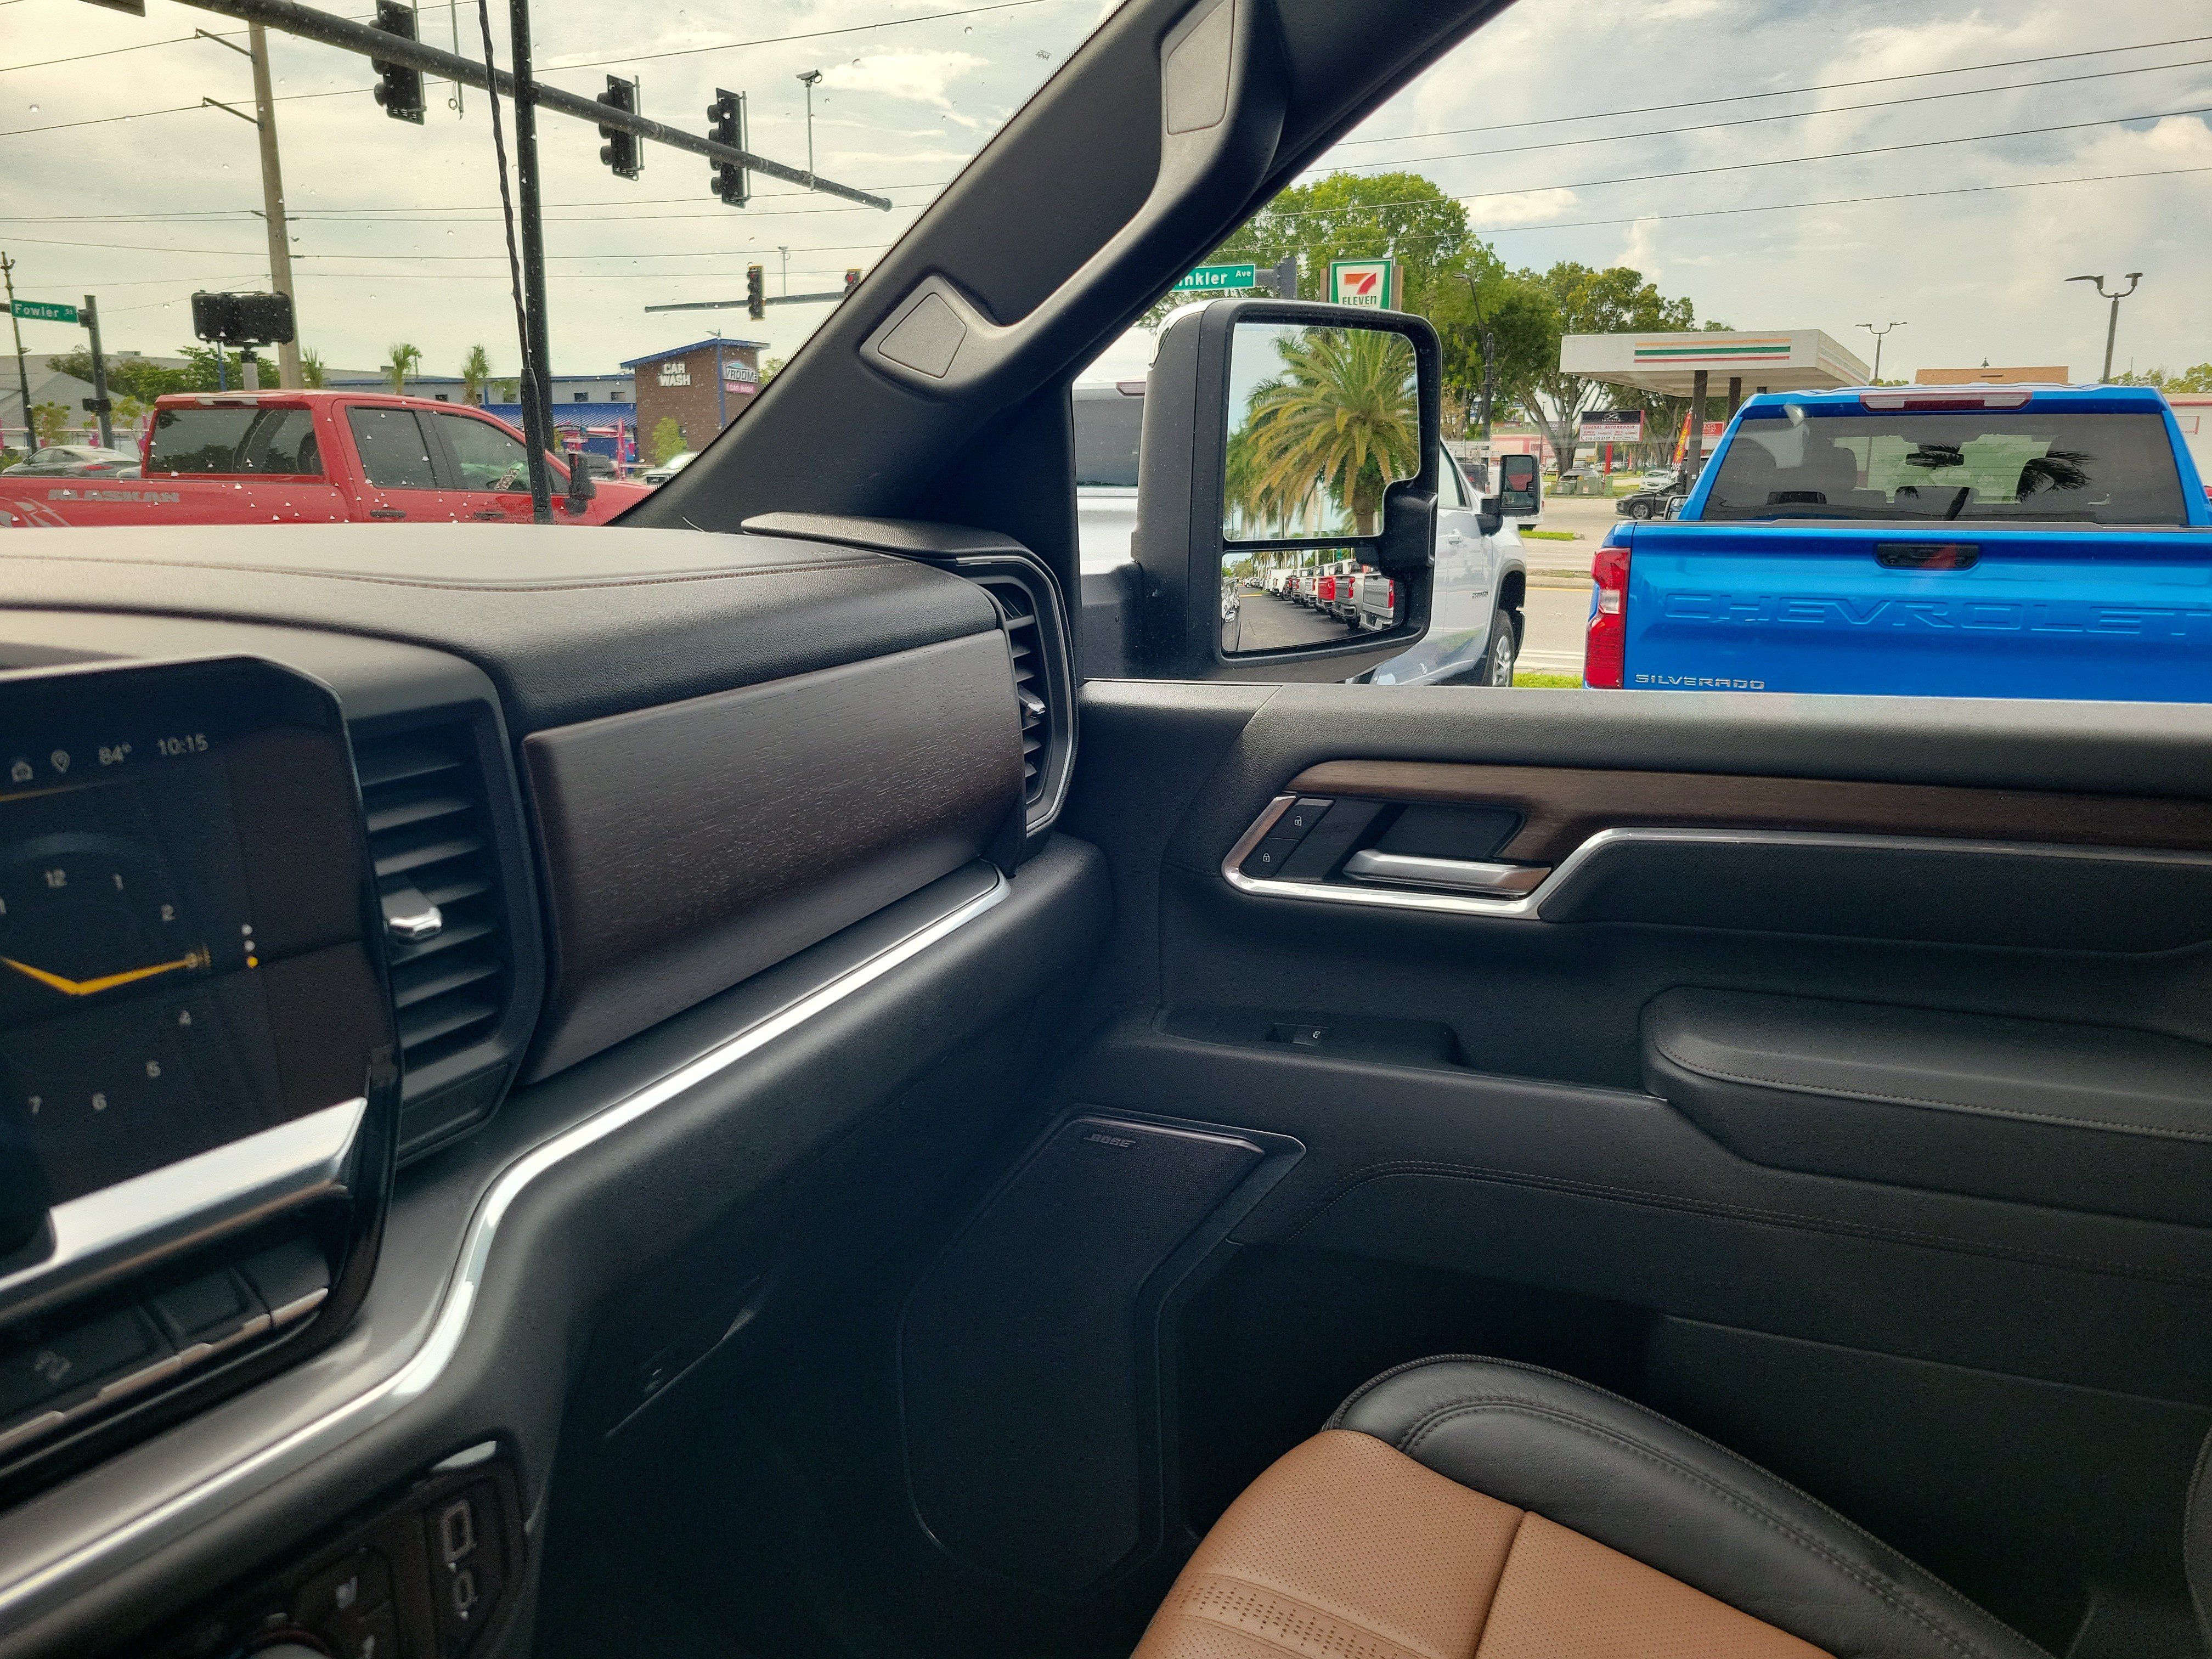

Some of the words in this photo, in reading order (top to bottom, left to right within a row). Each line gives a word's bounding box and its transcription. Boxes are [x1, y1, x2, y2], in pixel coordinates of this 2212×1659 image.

[1344, 272, 1376, 295] 7
[14, 303, 59, 318] Fowler
[663, 362, 685, 374] CAR
[659, 374, 691, 386] WASH
[48, 489, 180, 503] ALASKAN
[1664, 593, 2212, 636] CHEVROLET
[1635, 673, 1765, 690] SILVERADO
[157, 732, 209, 755] 10:15
[161, 904, 176, 922] 2
[29, 1095, 42, 1115] 7
[92, 1092, 108, 1112] 6
